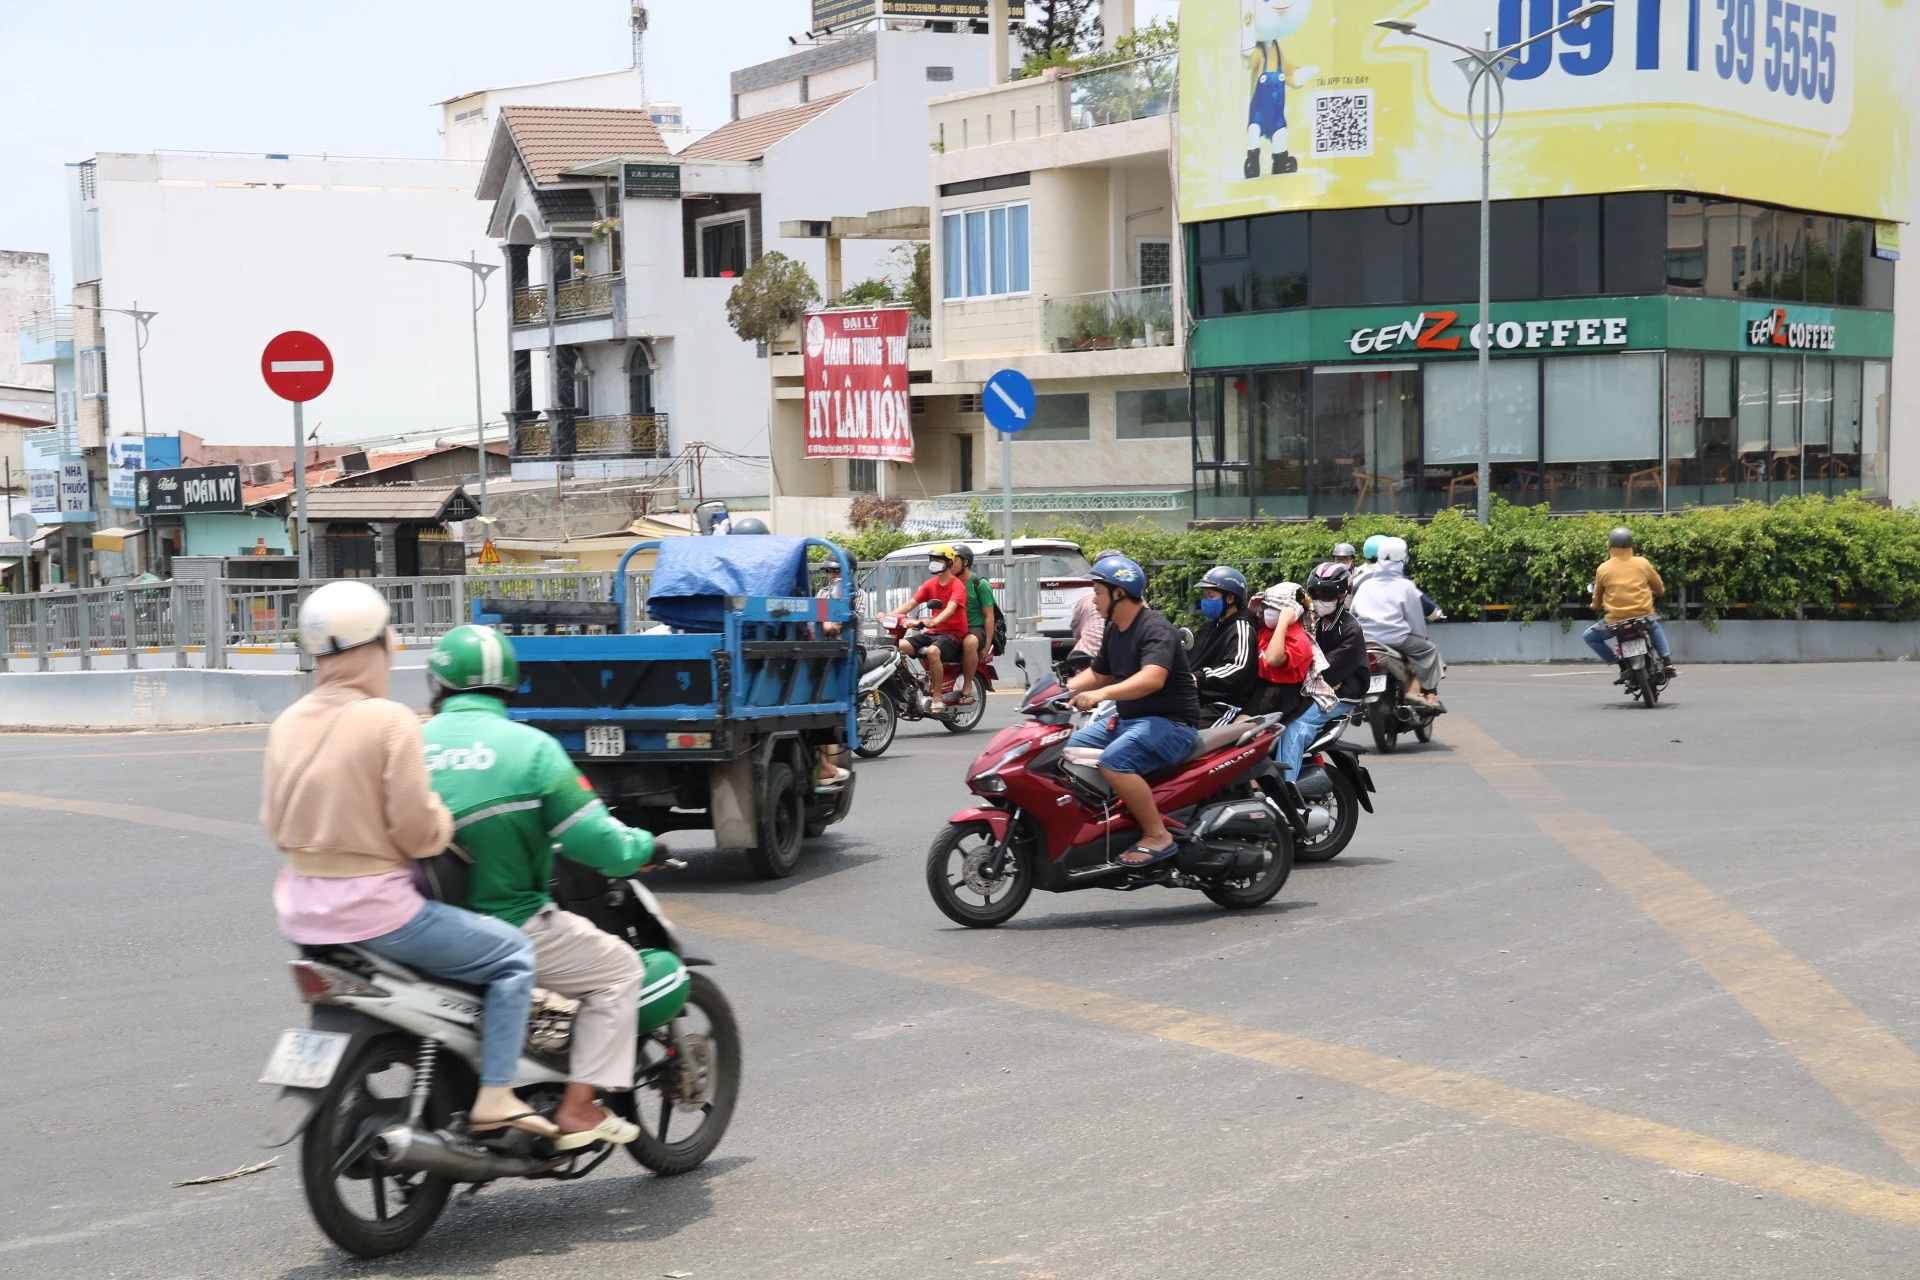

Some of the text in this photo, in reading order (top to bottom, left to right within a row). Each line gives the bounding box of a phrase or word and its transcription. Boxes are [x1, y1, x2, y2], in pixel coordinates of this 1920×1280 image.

[1715, 0, 1755, 84] 39
[1764, 0, 1837, 104] 5555
[1327, 77, 1340, 86] APP
[843, 315, 879, 329] ĐẠI LÝ
[1469, 317, 1627, 349] COFFEE
[1788, 322, 1836, 350] COFFEE
[823, 332, 850, 366] BÁNH
[852, 337, 883, 366] TRUNG
[833, 375, 867, 438] LÂM
[64, 462, 82, 477] NHÀ
[61, 479, 88, 494] THUỐC
[67, 496, 83, 511] TÂY
[424, 741, 497, 771] Grab
